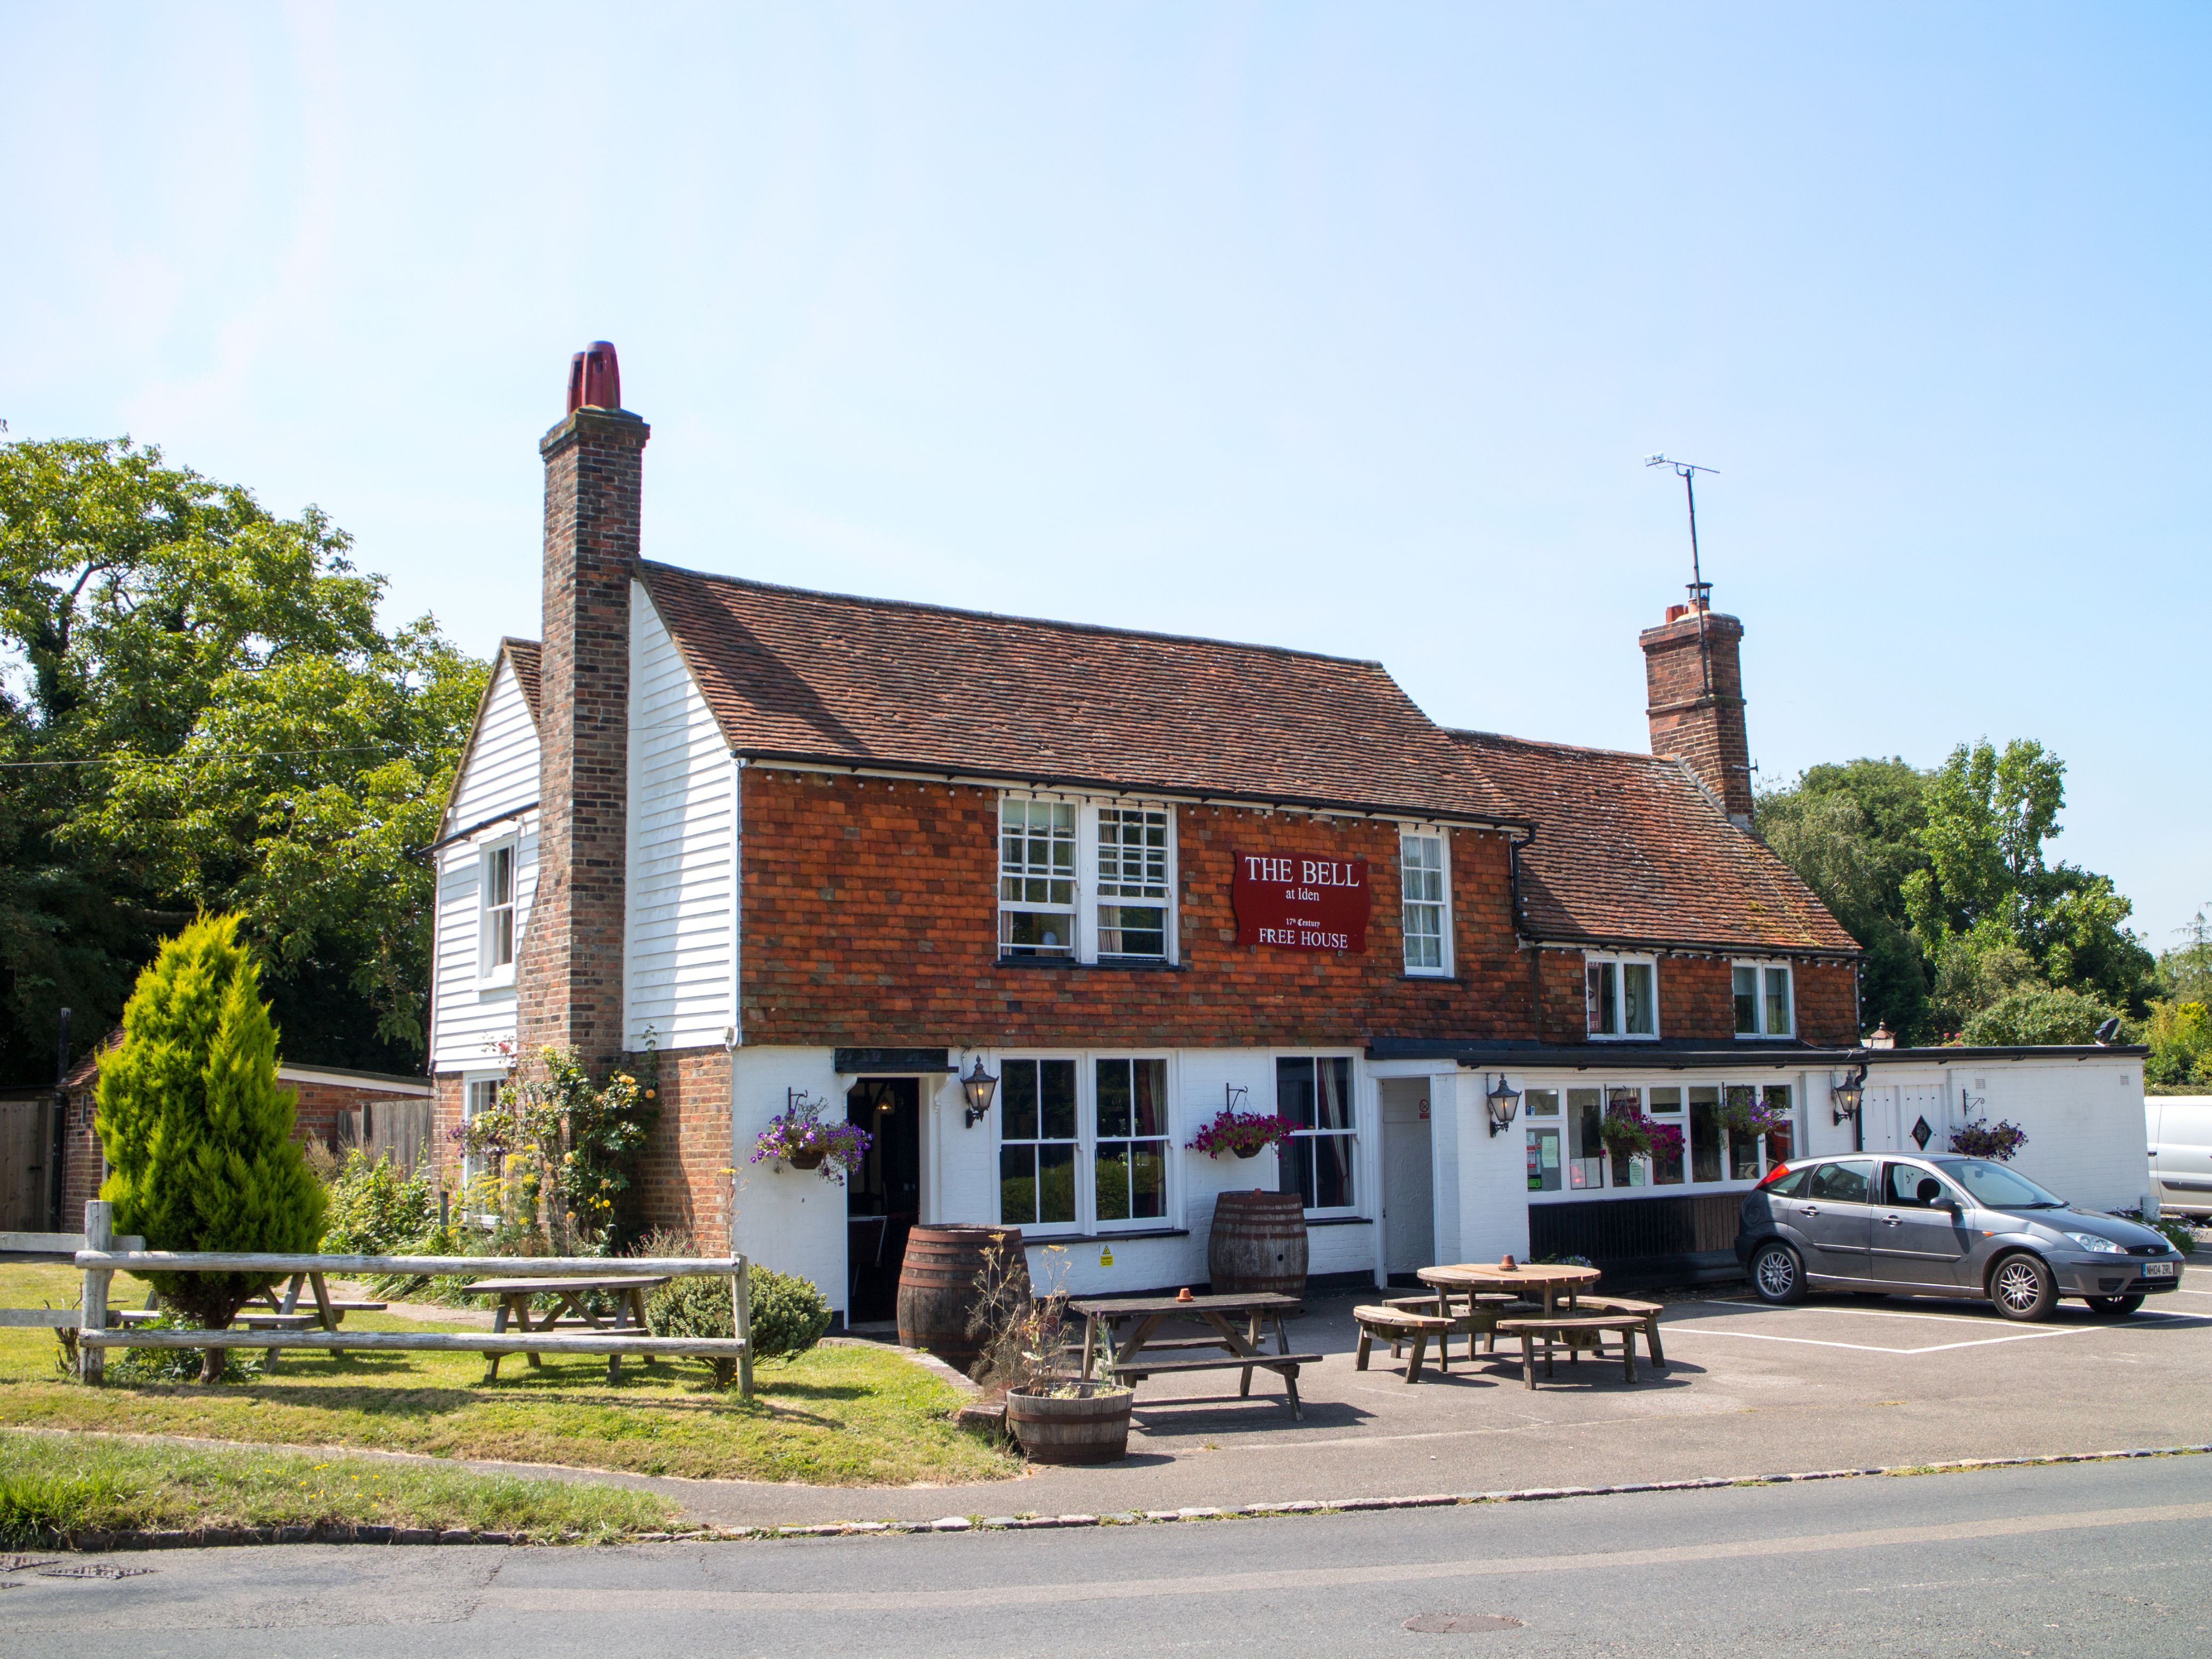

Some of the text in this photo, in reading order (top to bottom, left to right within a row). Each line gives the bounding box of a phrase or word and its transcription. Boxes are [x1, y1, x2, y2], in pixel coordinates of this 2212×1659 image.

[1245, 857, 1360, 887] THE BELL
[1286, 888, 1320, 902] at Iden
[1297, 919, 1320, 929] Century
[1259, 928, 1348, 948] FREE HOUSE
[2146, 1264, 2173, 1275] NH04 ZRL
